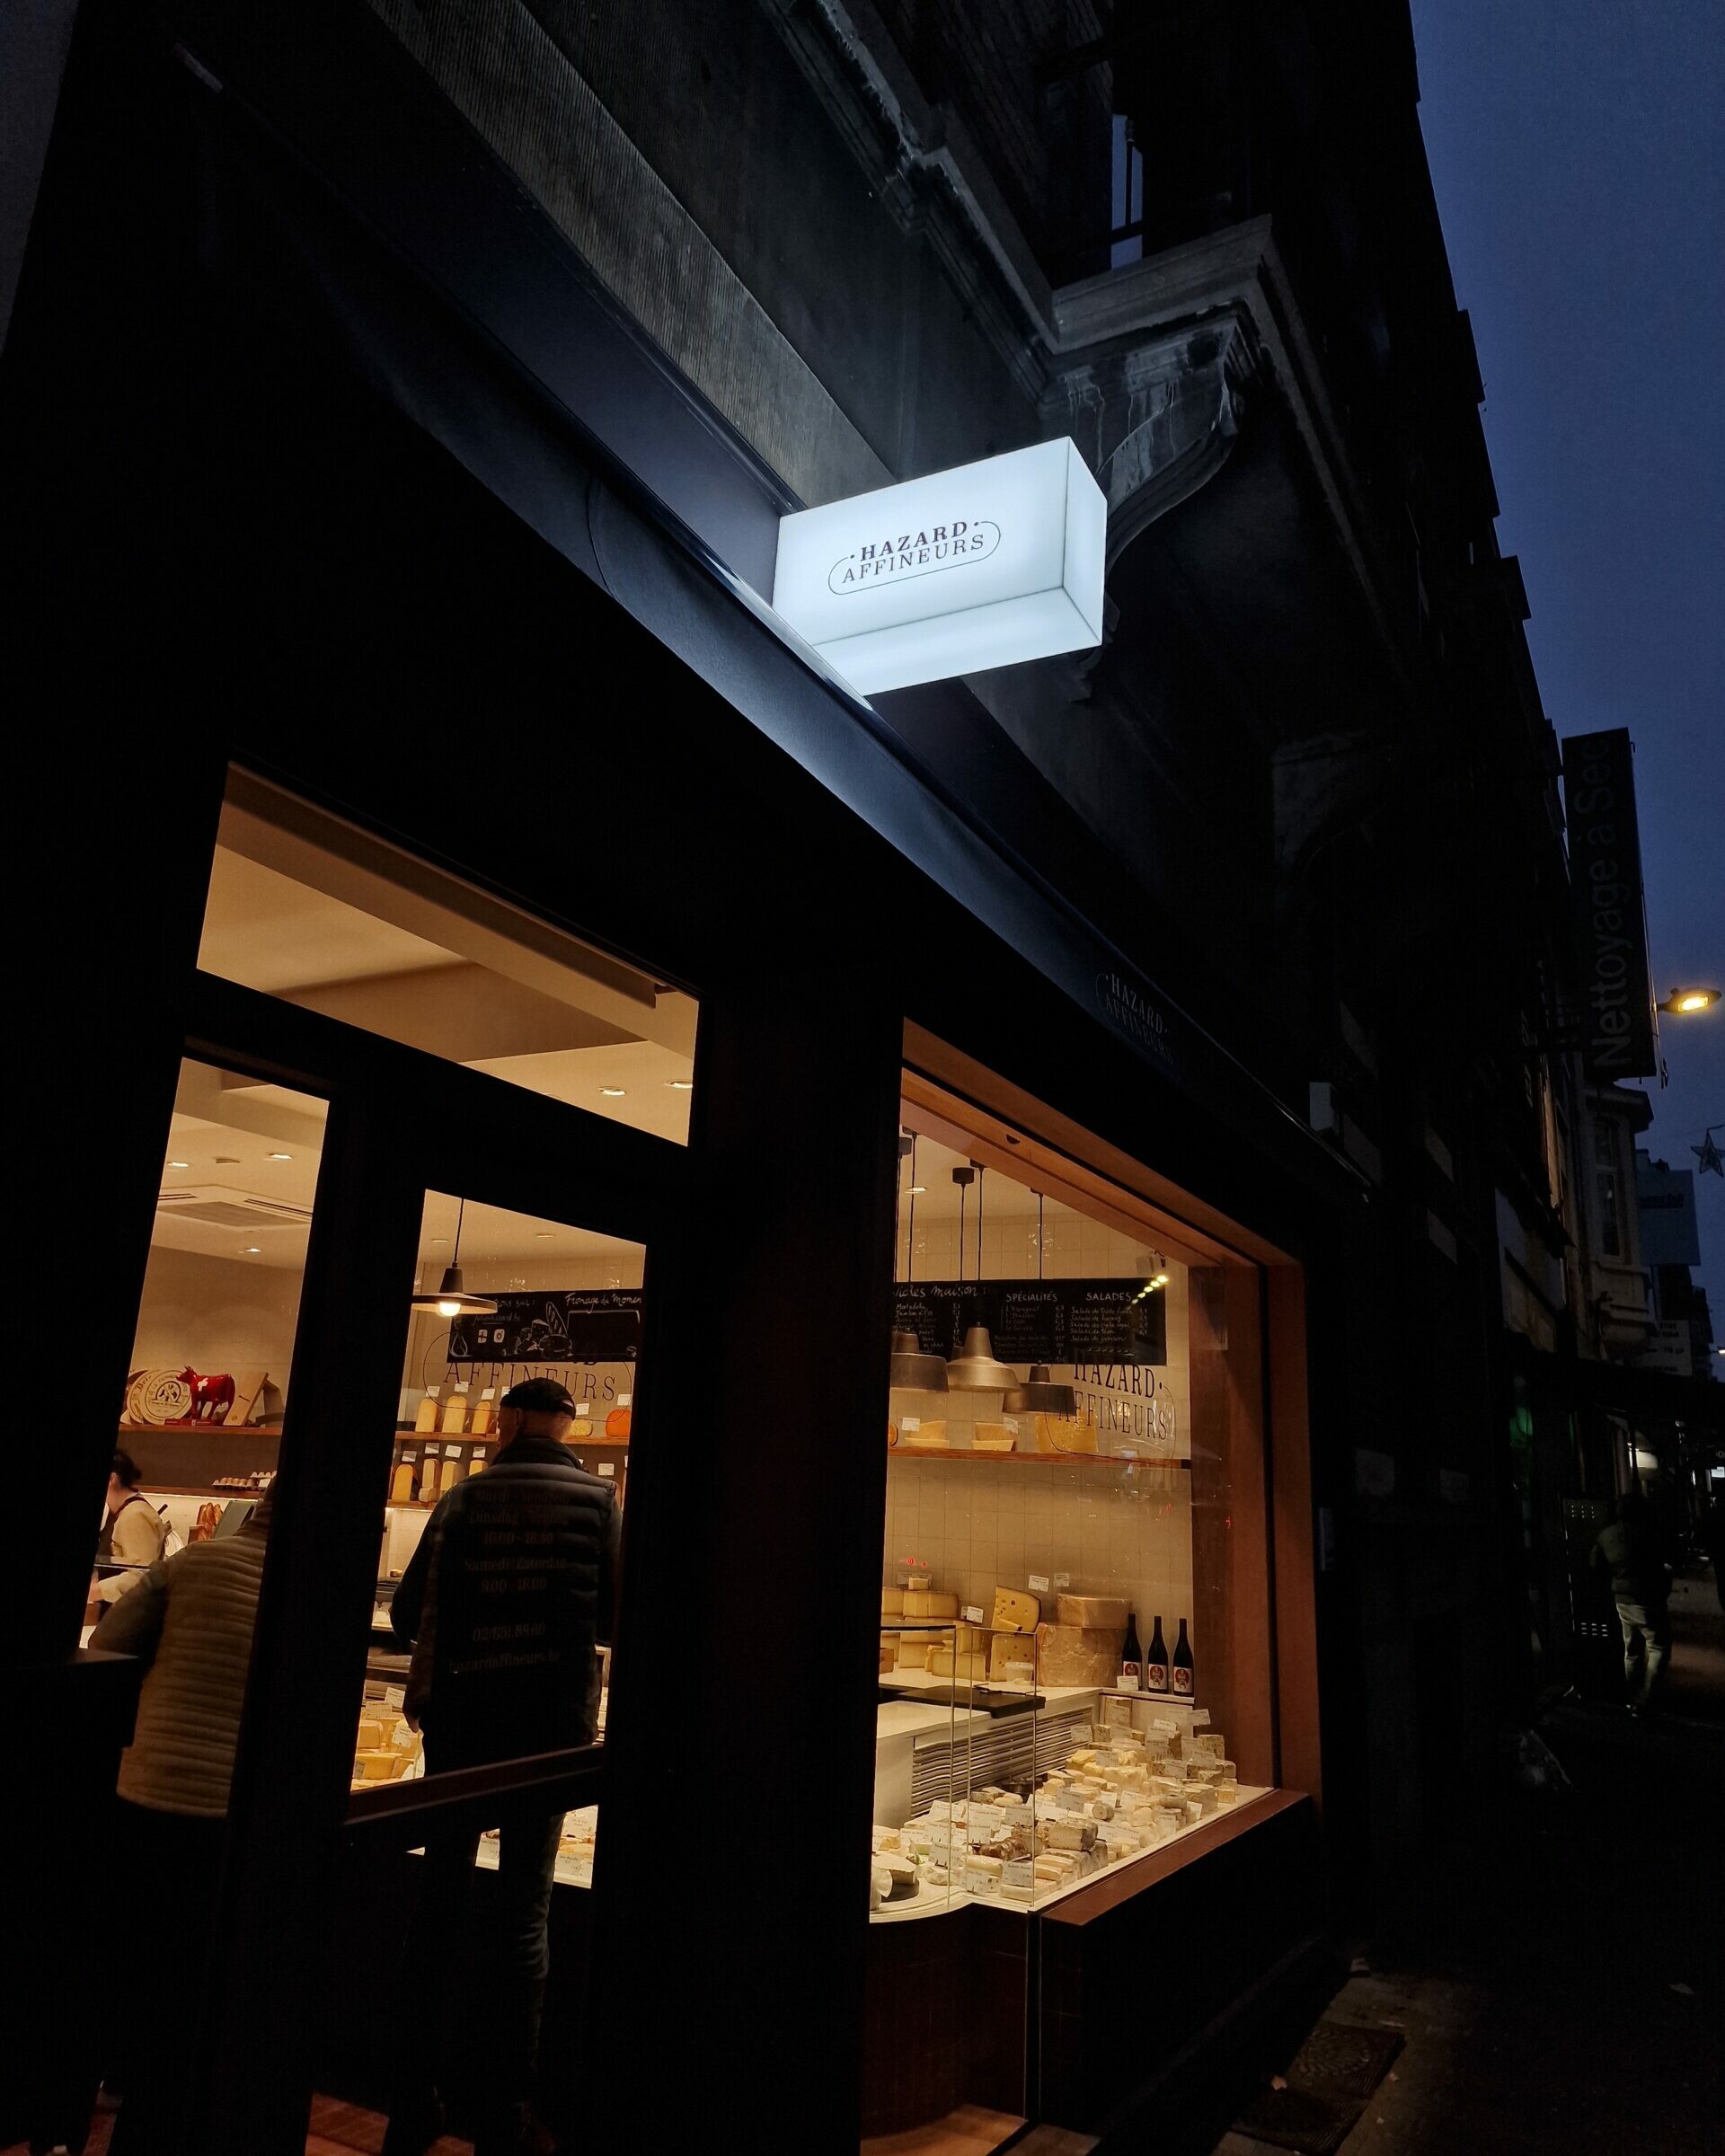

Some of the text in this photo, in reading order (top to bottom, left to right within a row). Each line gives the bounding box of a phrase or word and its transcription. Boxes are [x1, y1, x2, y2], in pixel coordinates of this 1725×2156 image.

[841, 533, 986, 584] AFFINEURS
[859, 520, 969, 562] HAZARD
[1573, 734, 1613, 816] Sec
[1588, 856, 1633, 1069] Nettoyage
[1110, 972, 1163, 1035] HAZARD
[564, 1292, 599, 1314] Fromage
[1084, 1291, 1132, 1302] SALADES
